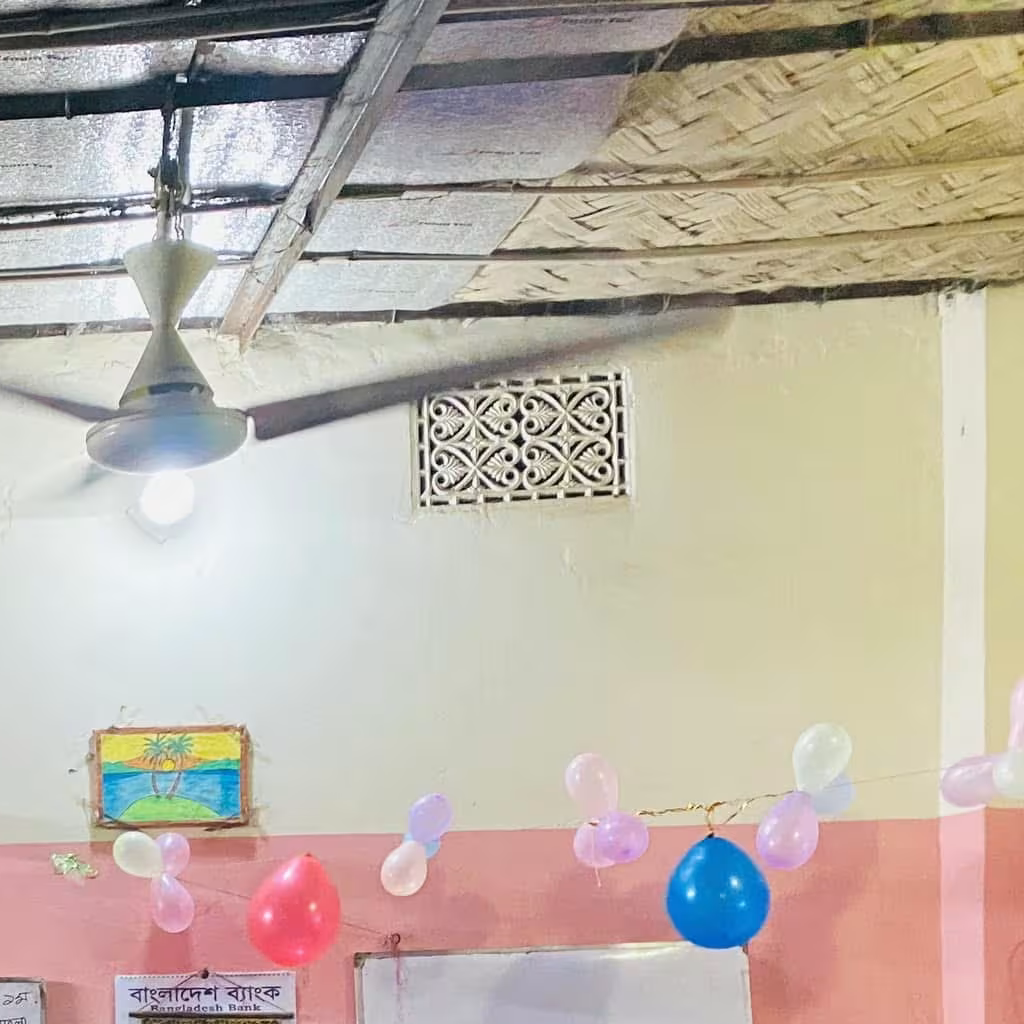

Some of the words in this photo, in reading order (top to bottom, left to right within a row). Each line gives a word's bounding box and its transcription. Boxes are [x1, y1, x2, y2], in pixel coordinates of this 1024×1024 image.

[128, 985, 219, 1004] বাংলাদেশ
[227, 985, 281, 1002] ব্যাংক
[150, 1003, 223, 1012] Bangladesh
[228, 1003, 262, 1012] Bank
